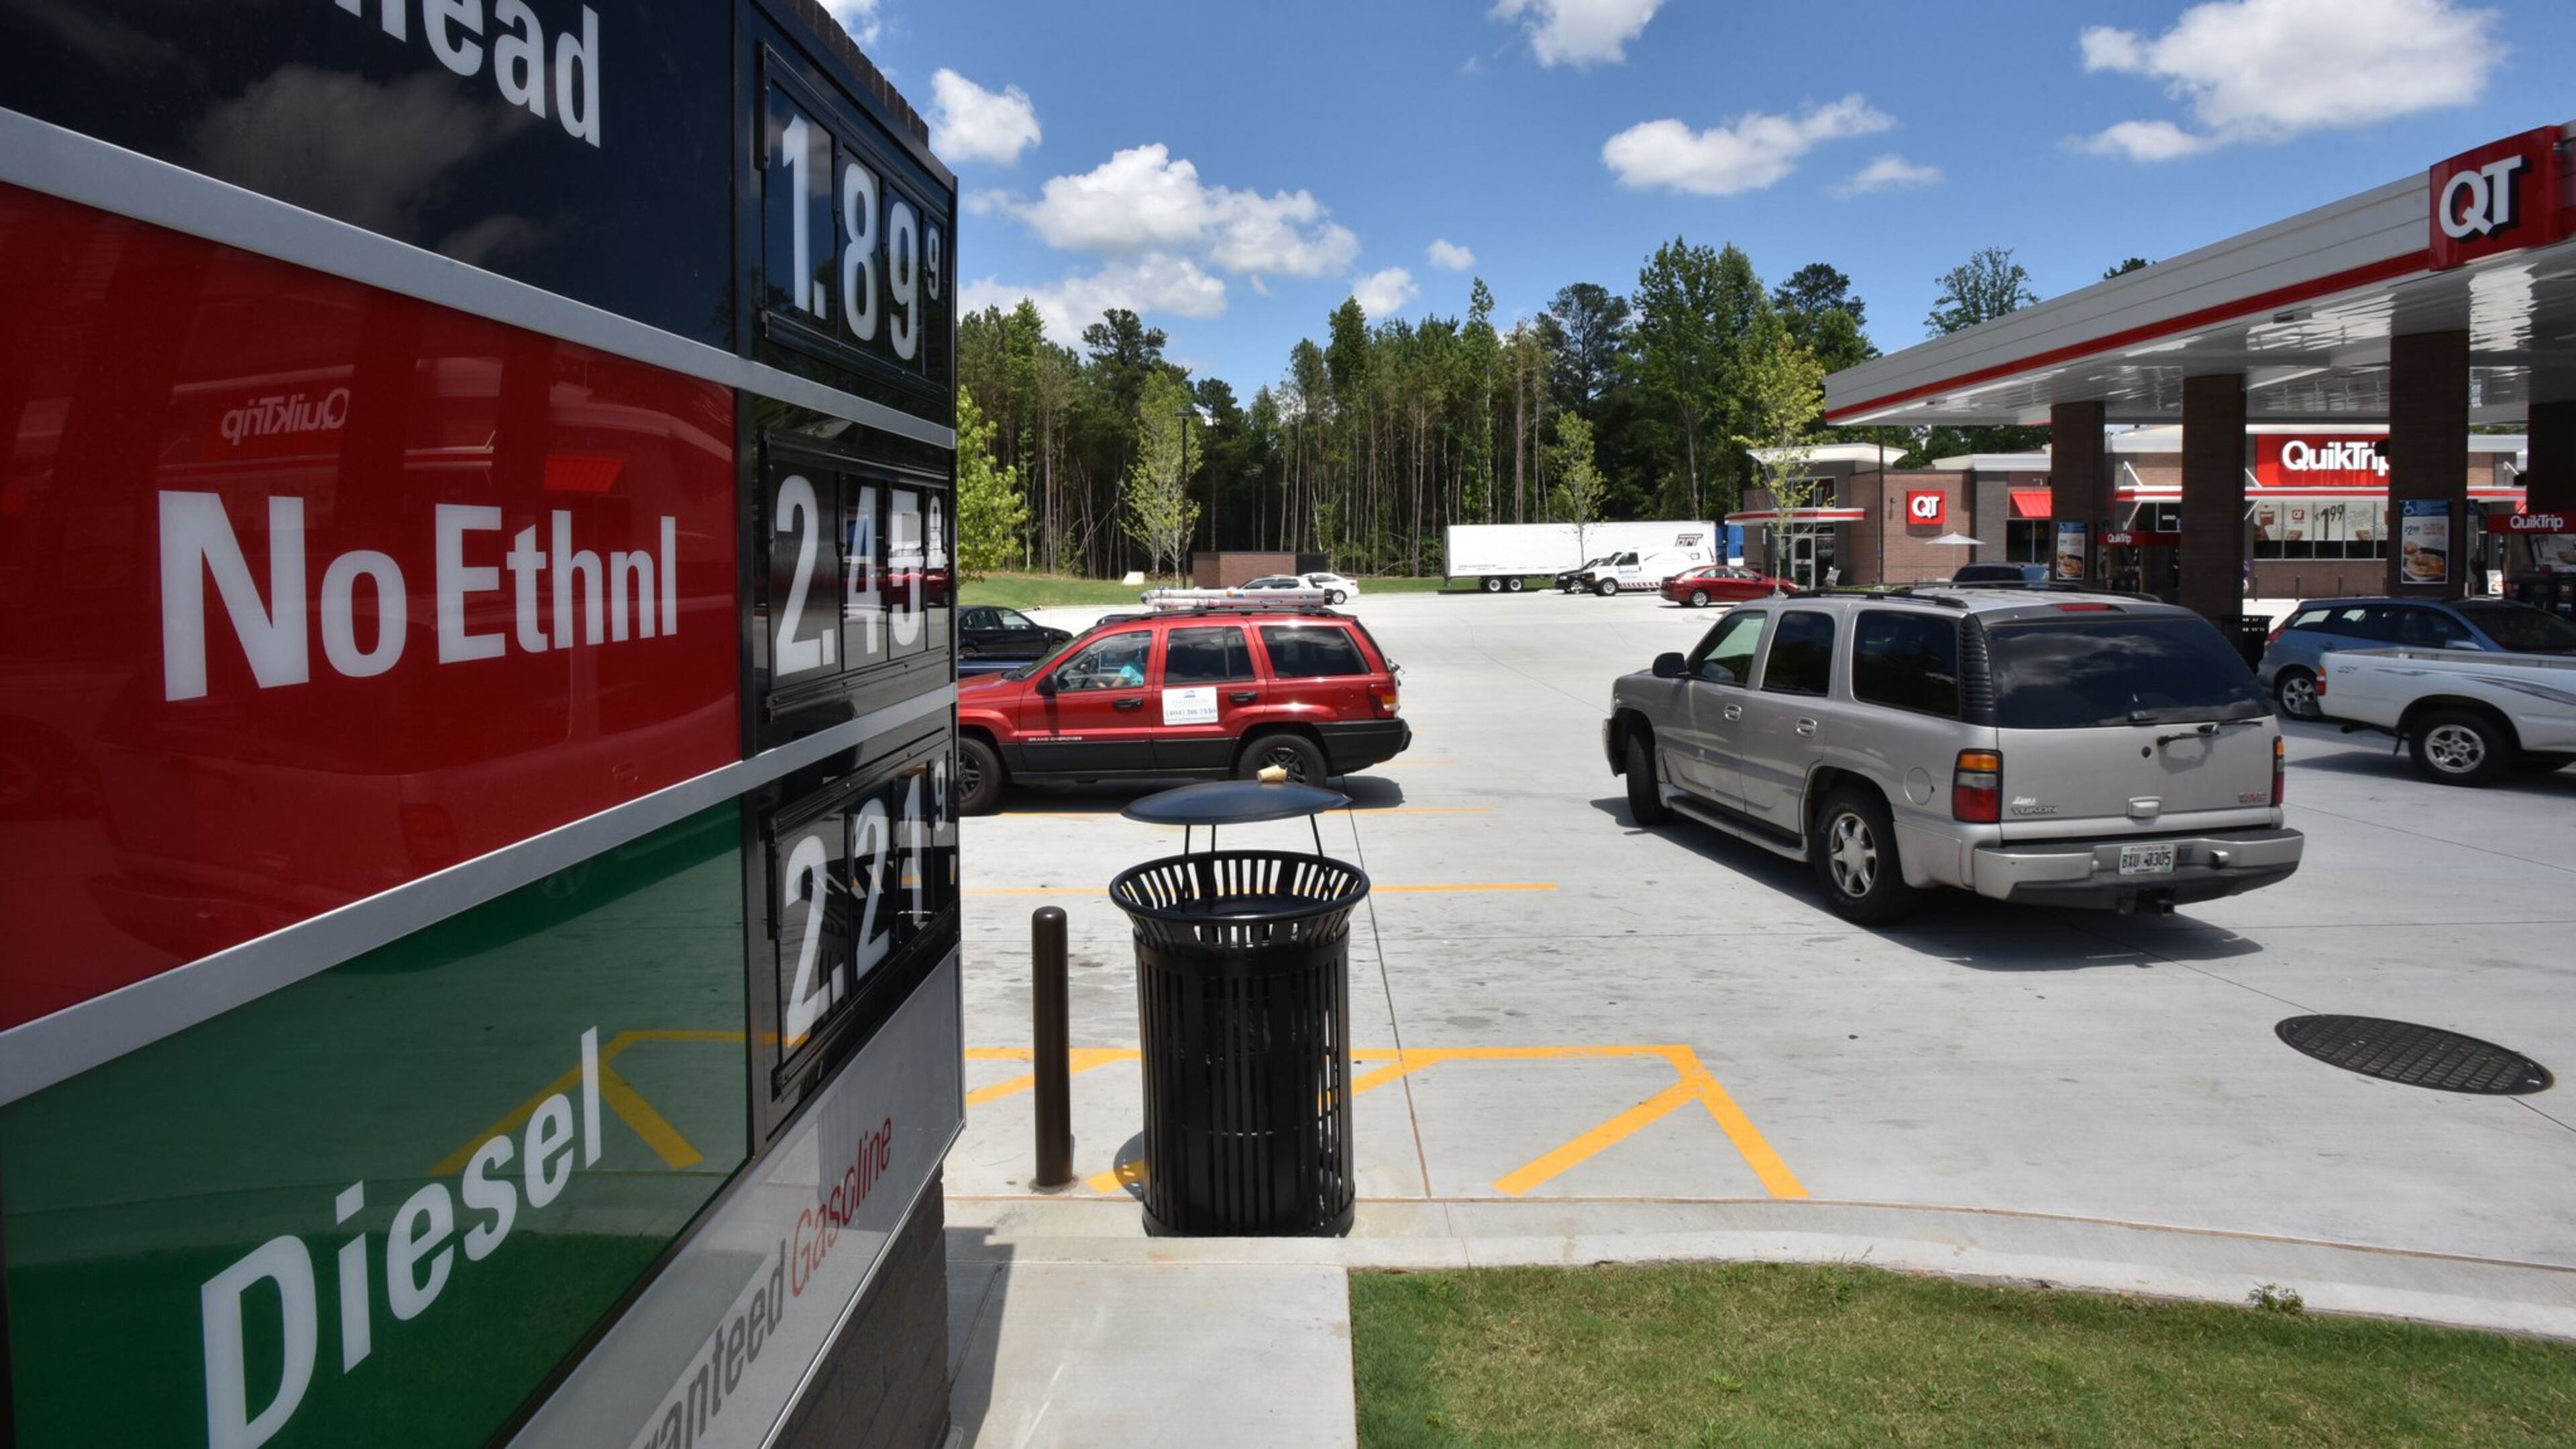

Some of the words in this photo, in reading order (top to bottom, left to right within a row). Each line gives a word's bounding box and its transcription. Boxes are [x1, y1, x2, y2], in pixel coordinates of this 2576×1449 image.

[334, 0, 600, 148] ead
[2439, 154, 2522, 239] QT
[1912, 496, 1940, 519] QT
[2510, 515, 2564, 531] QuikTrip
[158, 490, 407, 702] No
[435, 503, 678, 665] Ethnl
[2011, 805, 2057, 816] YUKON
[201, 1026, 602, 1449] Diesel
[792, 1117, 892, 1297] Gasoline
